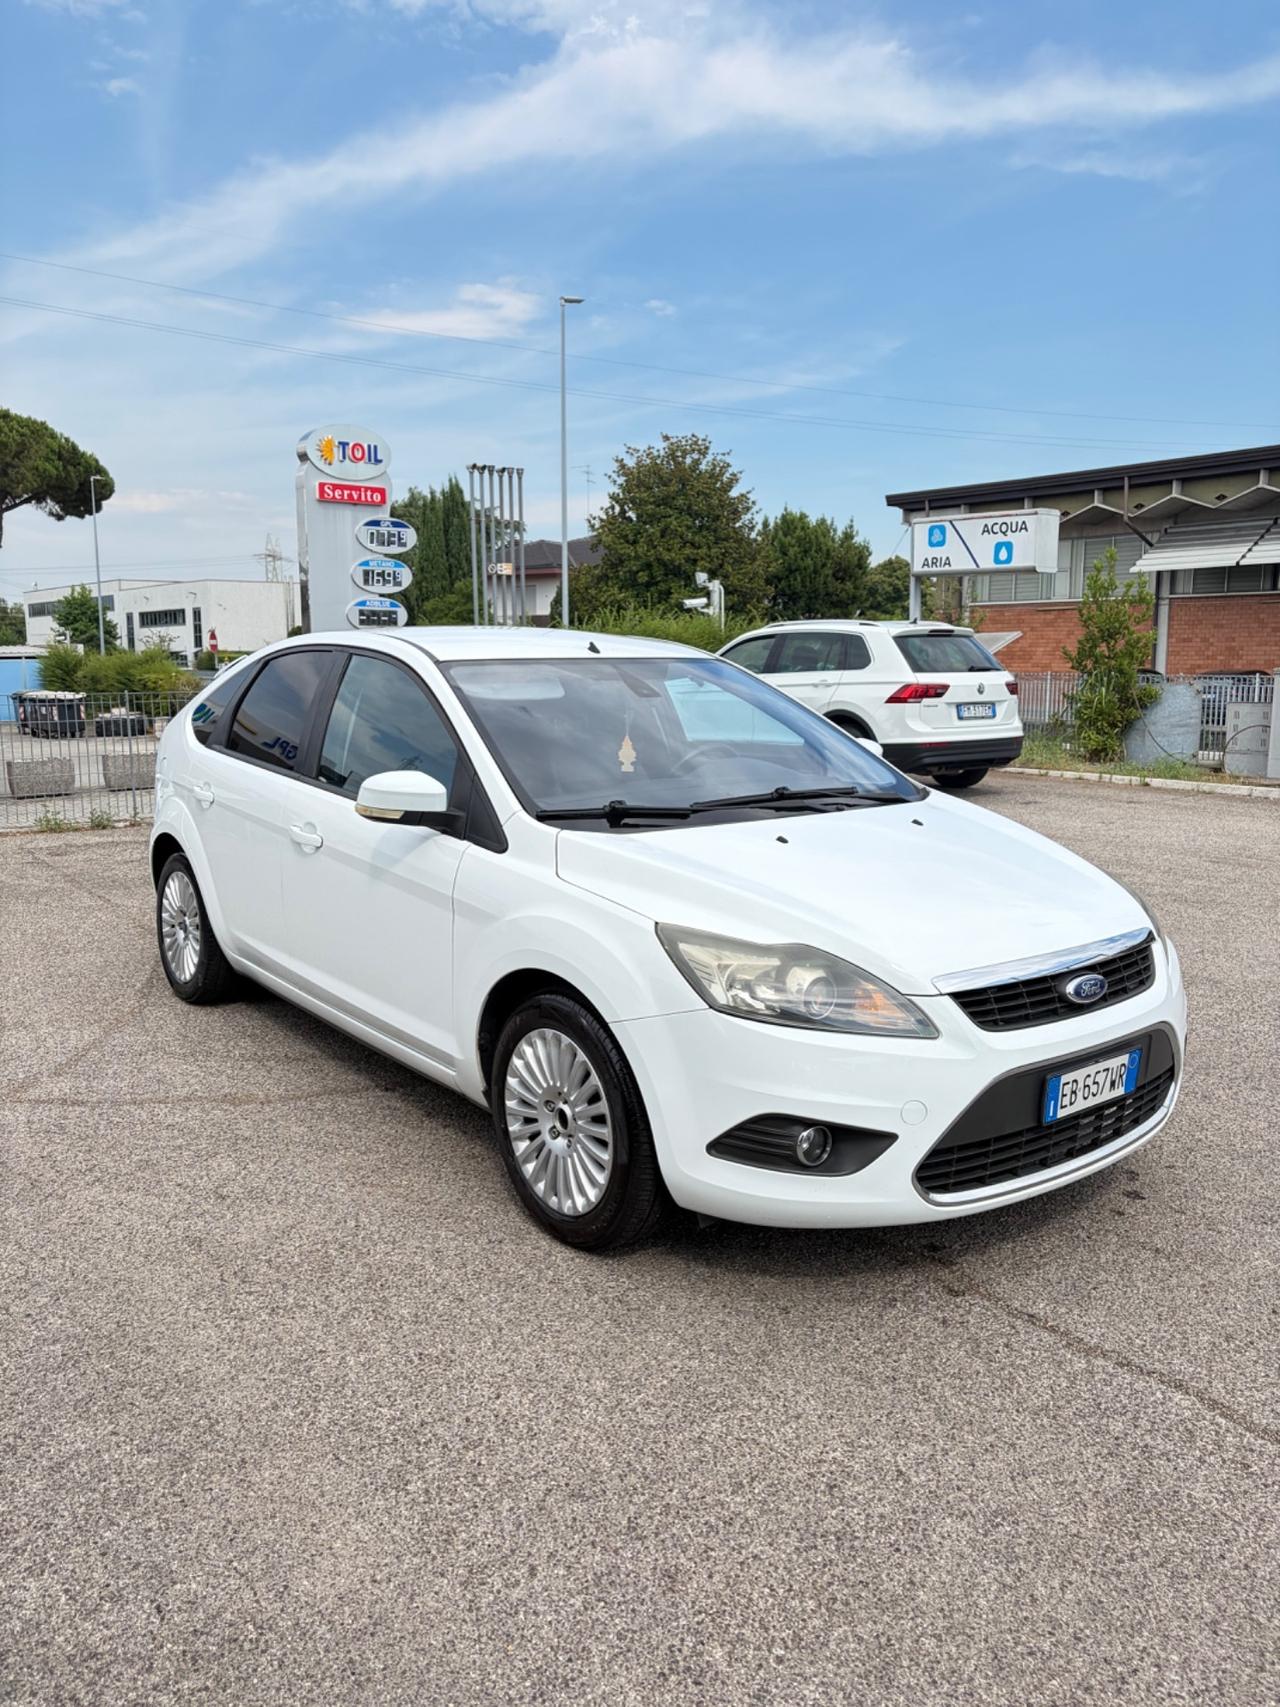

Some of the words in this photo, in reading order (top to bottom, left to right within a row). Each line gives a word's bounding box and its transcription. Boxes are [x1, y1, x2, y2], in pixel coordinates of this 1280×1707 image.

[337, 441, 383, 465] TOIL
[324, 484, 381, 503] Servito
[379, 520, 393, 528] GPL
[981, 520, 1029, 537] ACQUA
[921, 556, 952, 569] ARIA
